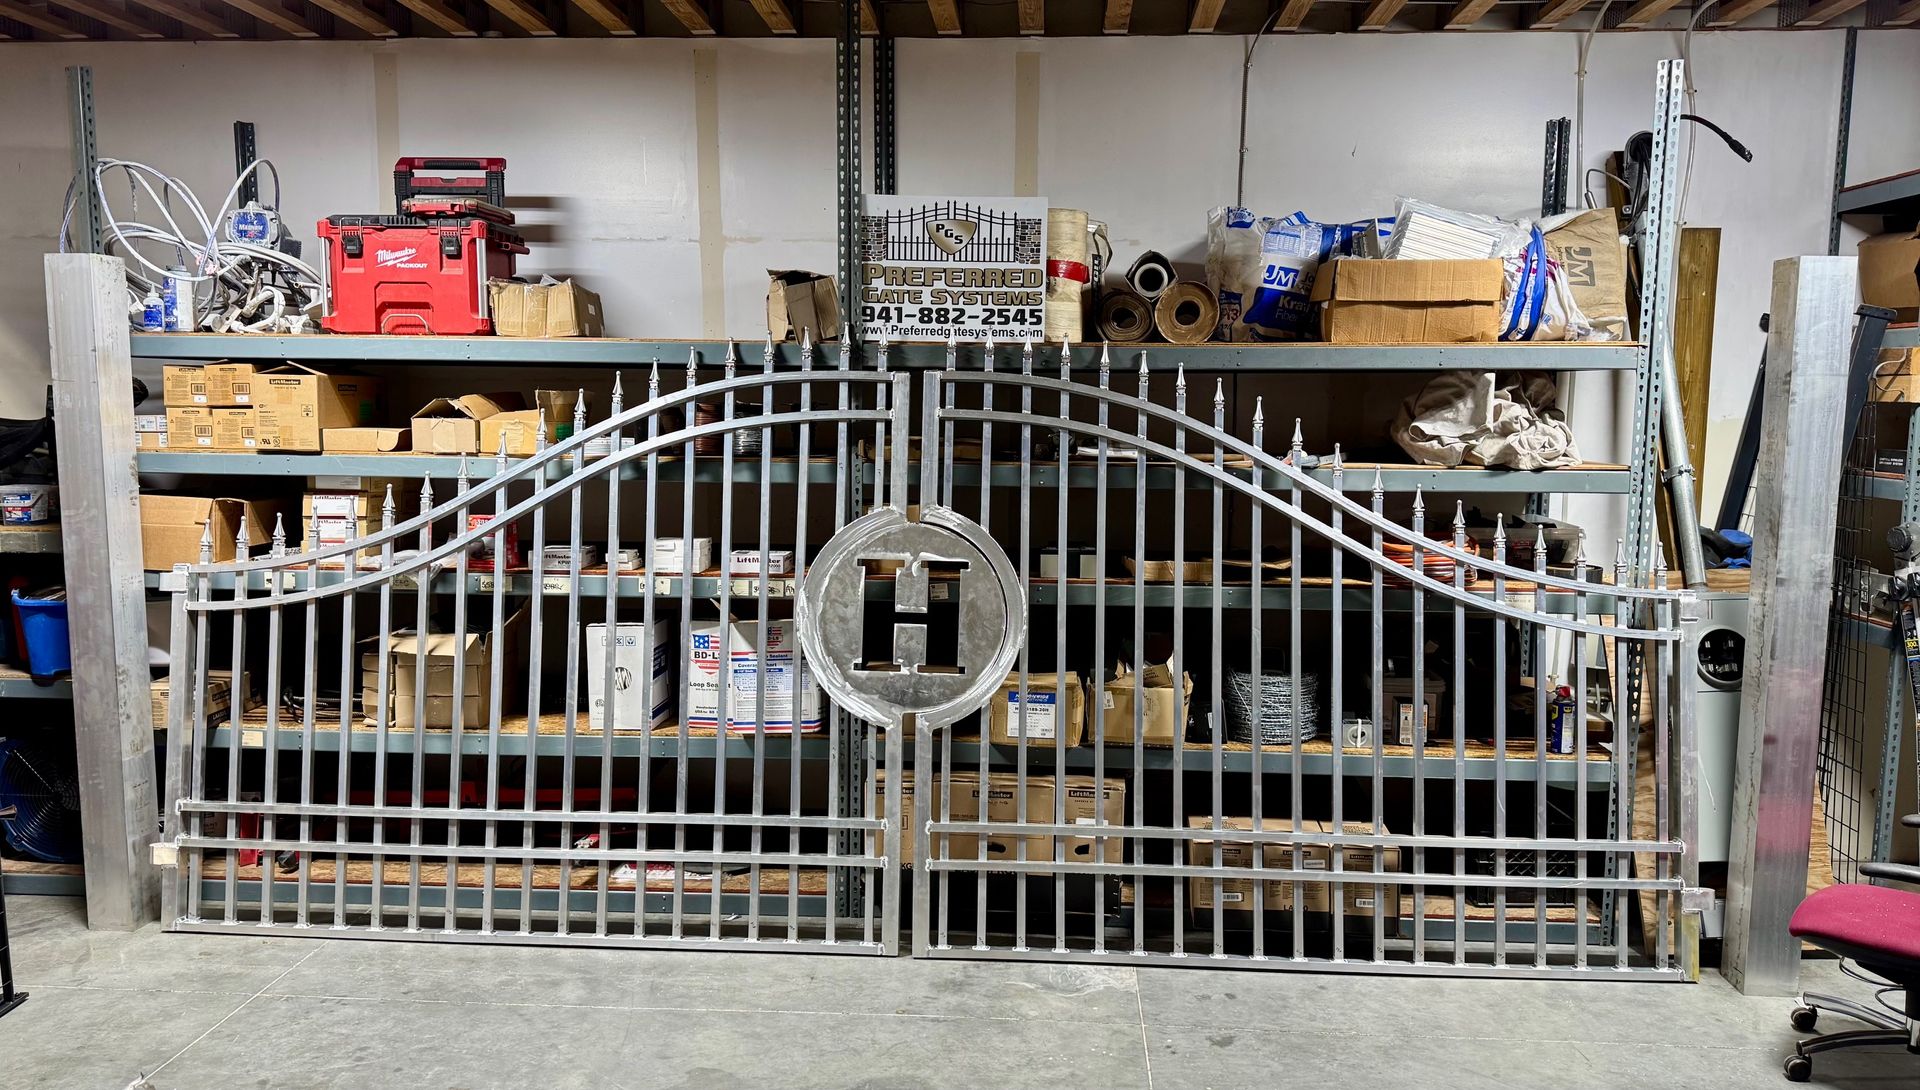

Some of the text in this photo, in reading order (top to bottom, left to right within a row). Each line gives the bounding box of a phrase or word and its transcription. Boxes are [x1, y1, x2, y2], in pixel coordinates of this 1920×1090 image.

[936, 223, 963, 244] PGS
[375, 247, 417, 263] Milwaukee
[862, 263, 1043, 288] PREFERRED
[1263, 264, 1300, 288] JM
[1565, 246, 1596, 286] JM
[862, 287, 1043, 306] GATE SYSTEMS
[862, 305, 1043, 326] 941-882-2545
[862, 325, 1043, 339] www.Preferredgatesysems.com
[854, 558, 969, 674] H
[694, 651, 719, 660] BD-L
[706, 681, 731, 689] Seat
